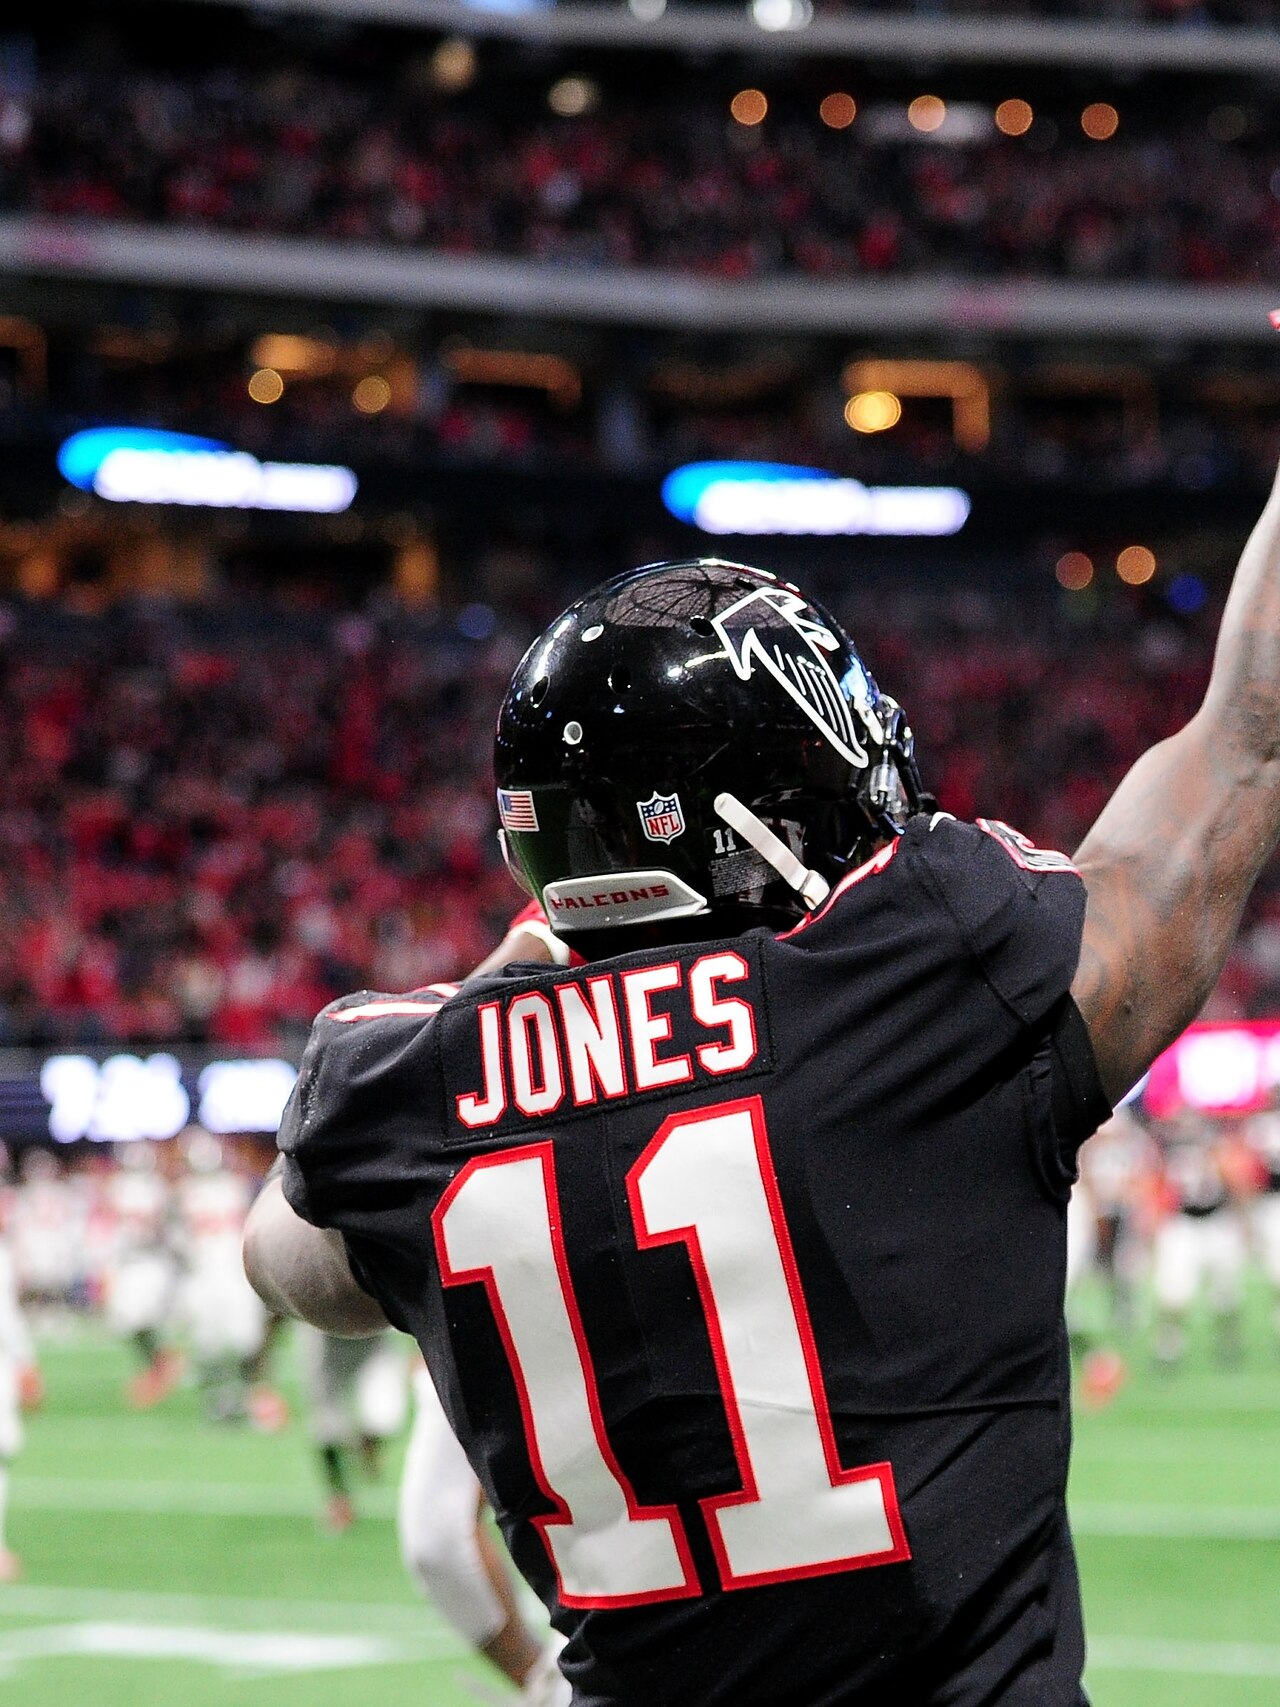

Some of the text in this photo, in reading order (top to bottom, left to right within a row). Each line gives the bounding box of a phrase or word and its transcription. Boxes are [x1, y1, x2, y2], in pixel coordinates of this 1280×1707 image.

[648, 814, 680, 836] NFL
[713, 828, 737, 854] 11
[551, 884, 669, 910] FALCONS
[456, 951, 757, 1129] JONES
[431, 1094, 912, 1609] 11
